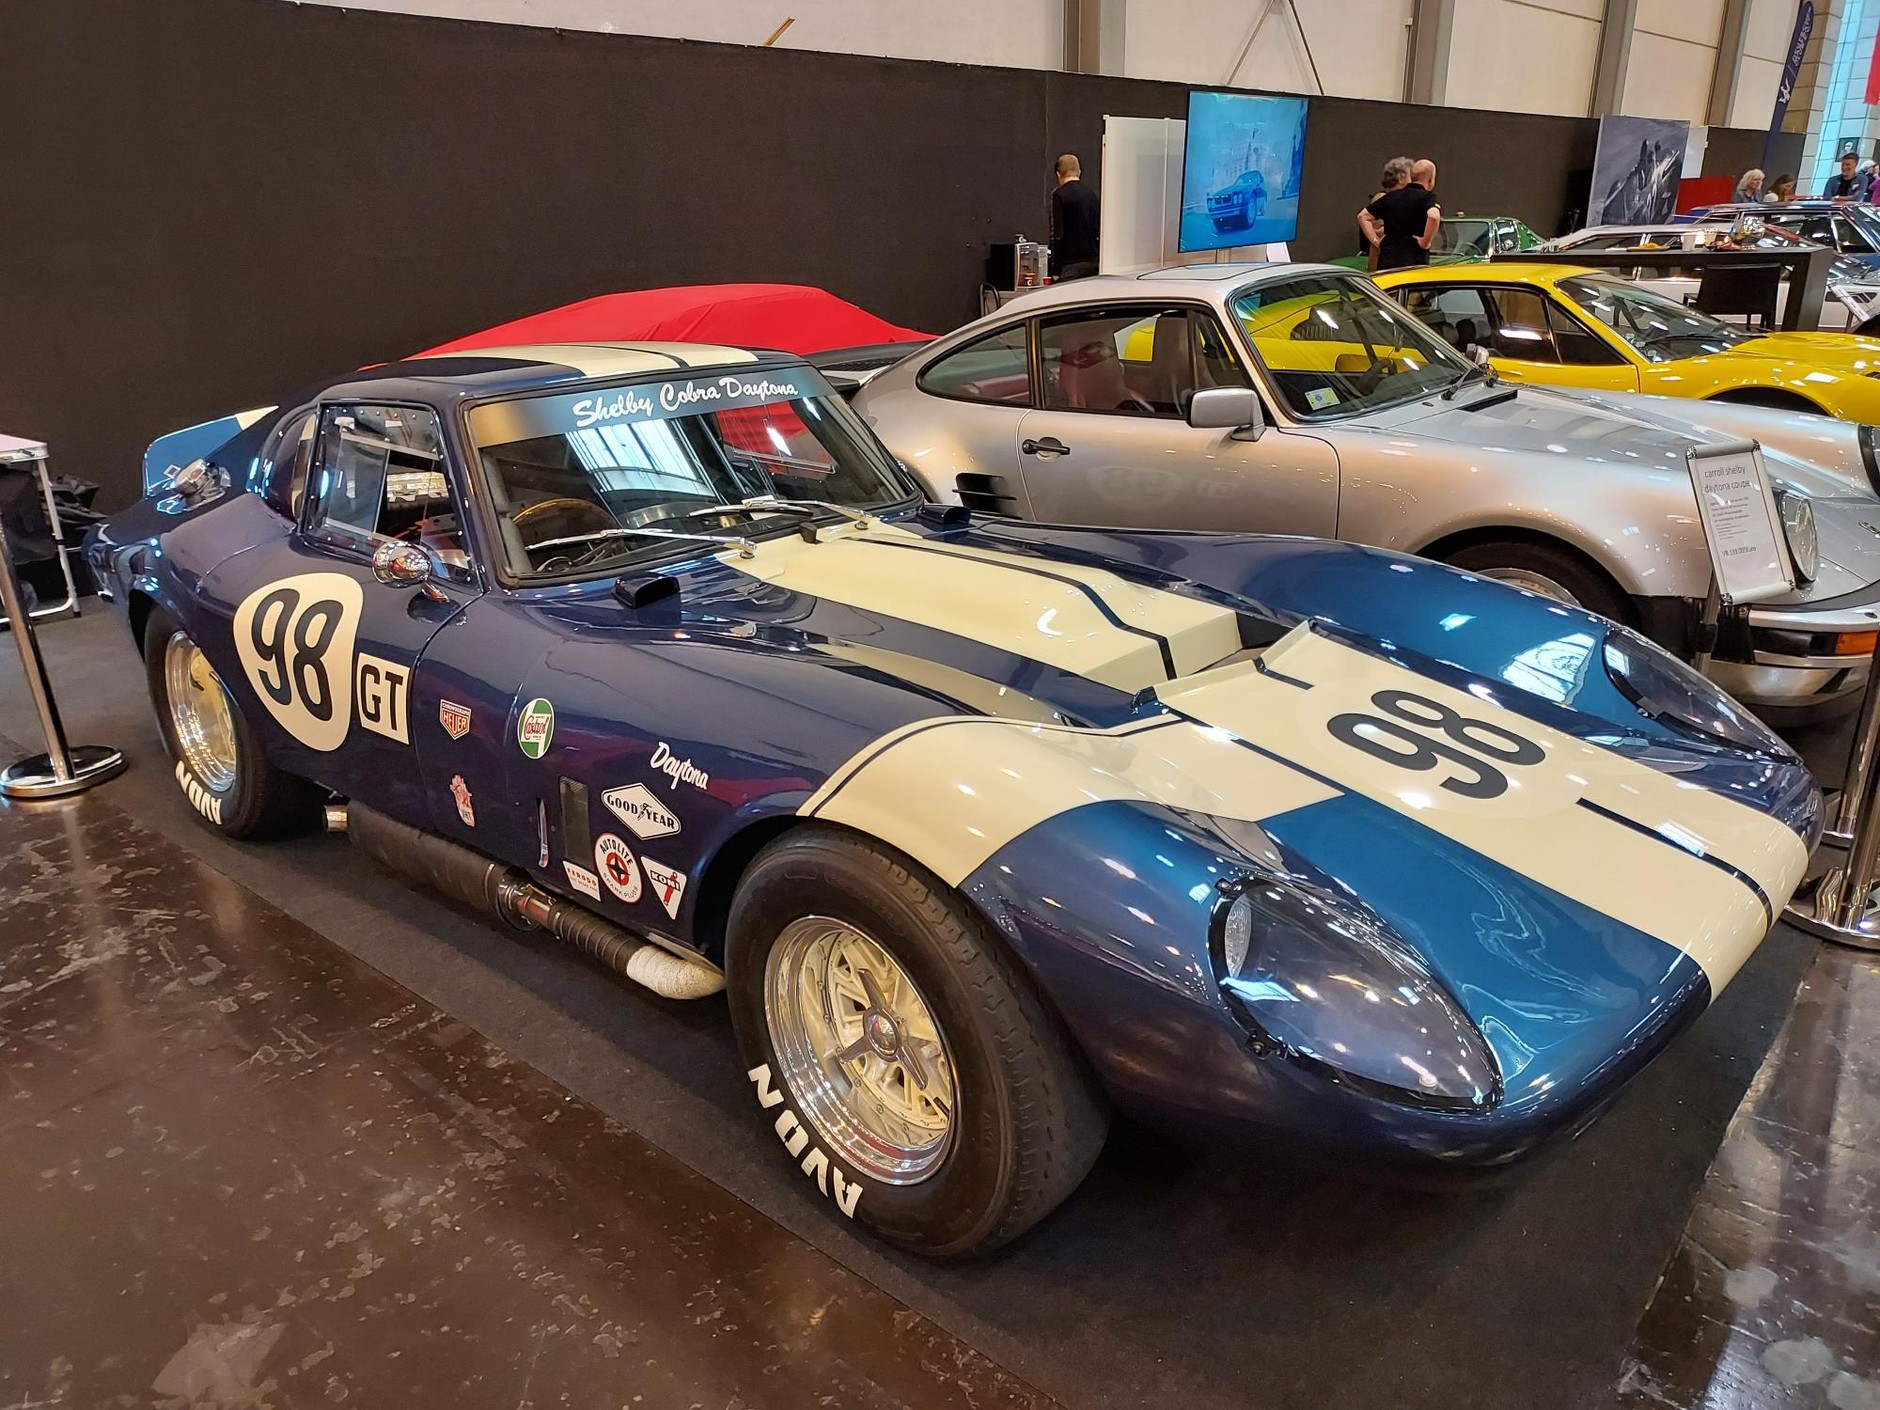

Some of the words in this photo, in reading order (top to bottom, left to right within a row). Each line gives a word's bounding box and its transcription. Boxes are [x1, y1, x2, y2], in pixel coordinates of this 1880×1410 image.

[572, 391, 654, 428] Shelby
[660, 381, 722, 411] Cobra
[720, 377, 799, 401] Daytona
[1704, 467, 1725, 478] carroll
[1725, 465, 1746, 476] shelby
[1704, 481, 1731, 493] daytona
[251, 588, 344, 722] 98
[360, 664, 404, 711] GT
[443, 710, 467, 734] HEUER
[524, 715, 549, 740] Castrol
[1327, 690, 1546, 799] 98
[650, 741, 709, 790] Daytona
[175, 760, 222, 825] AVON
[599, 838, 634, 866] AUTOLITE
[747, 1063, 864, 1219] AVON
